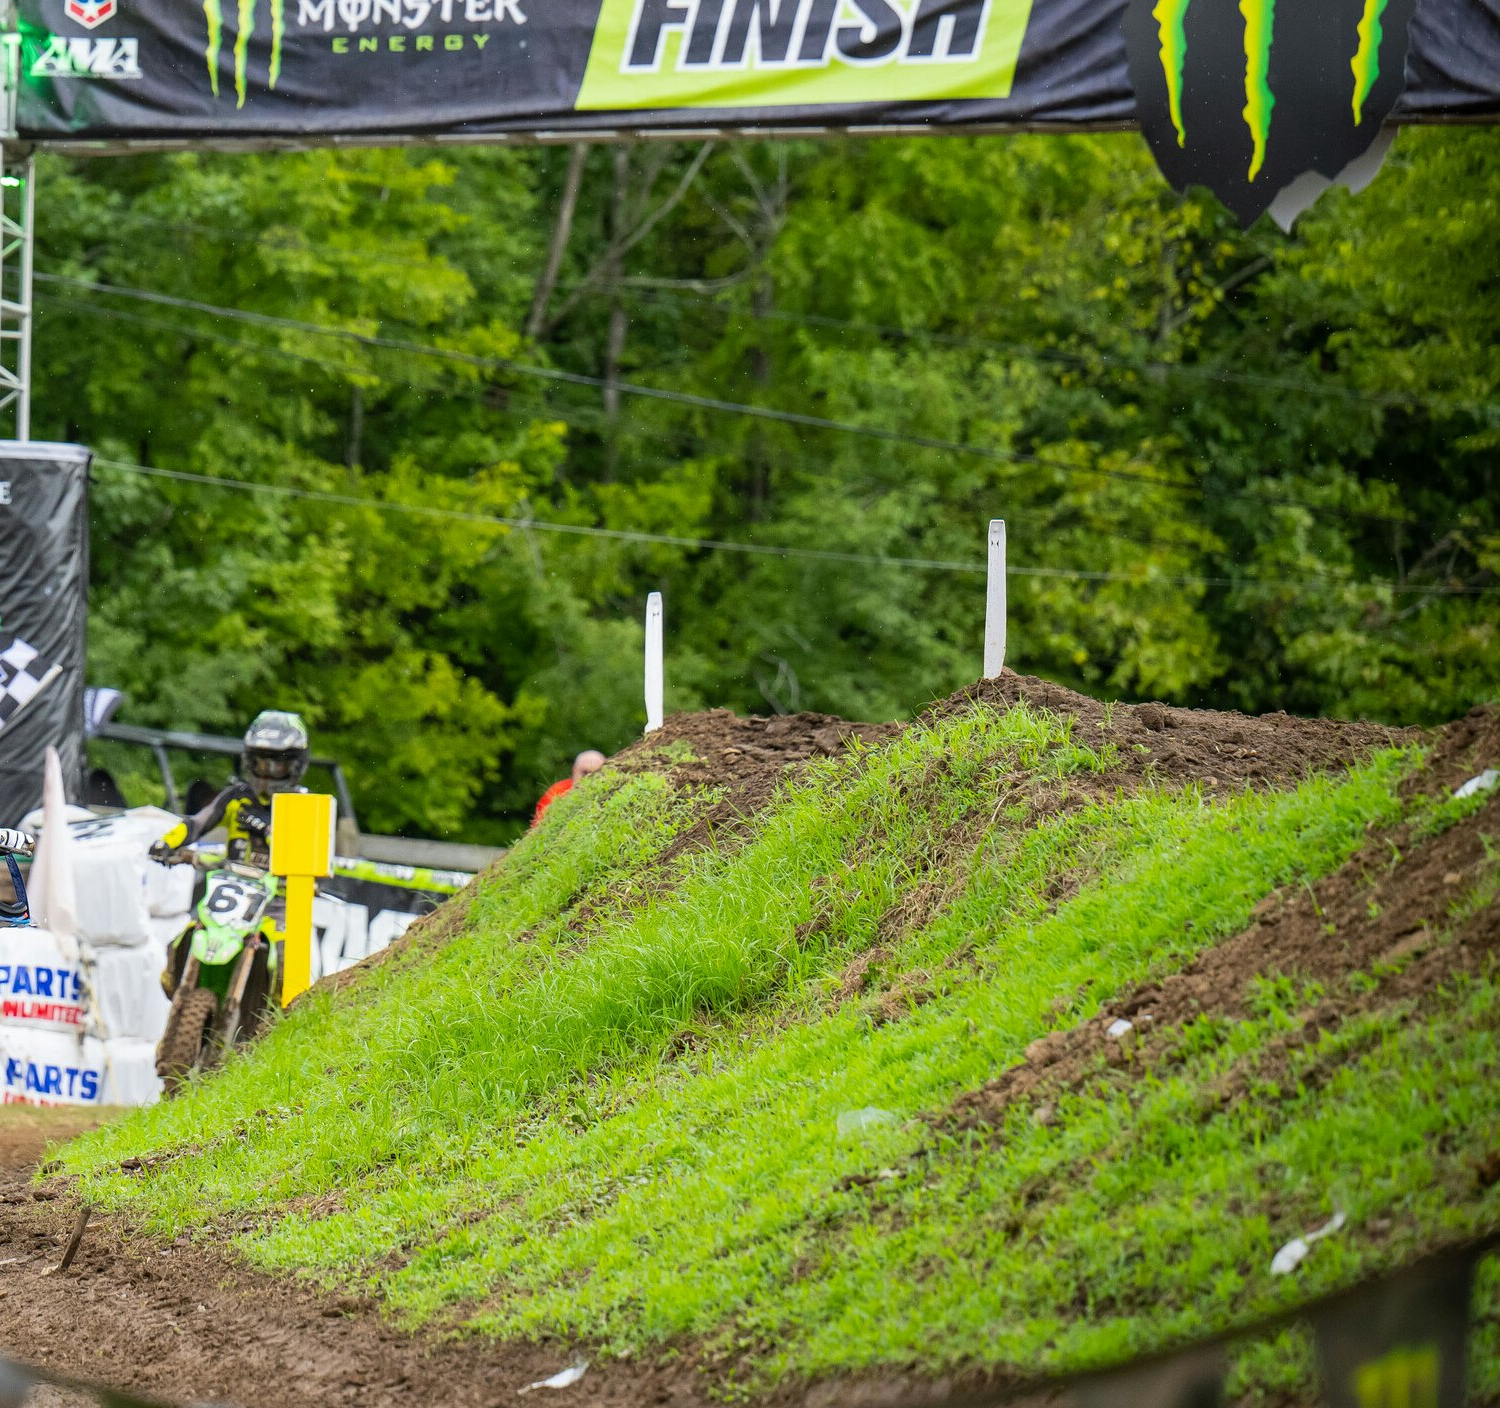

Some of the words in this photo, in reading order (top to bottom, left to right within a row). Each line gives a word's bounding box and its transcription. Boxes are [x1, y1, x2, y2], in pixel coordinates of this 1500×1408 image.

[297, 0, 527, 32] MONSTER
[332, 33, 490, 53] ENERGY
[618, 0, 994, 73] FINISH
[30, 36, 143, 77] AMA
[208, 884, 267, 922] 61
[6, 1057, 99, 1100] PARTS
